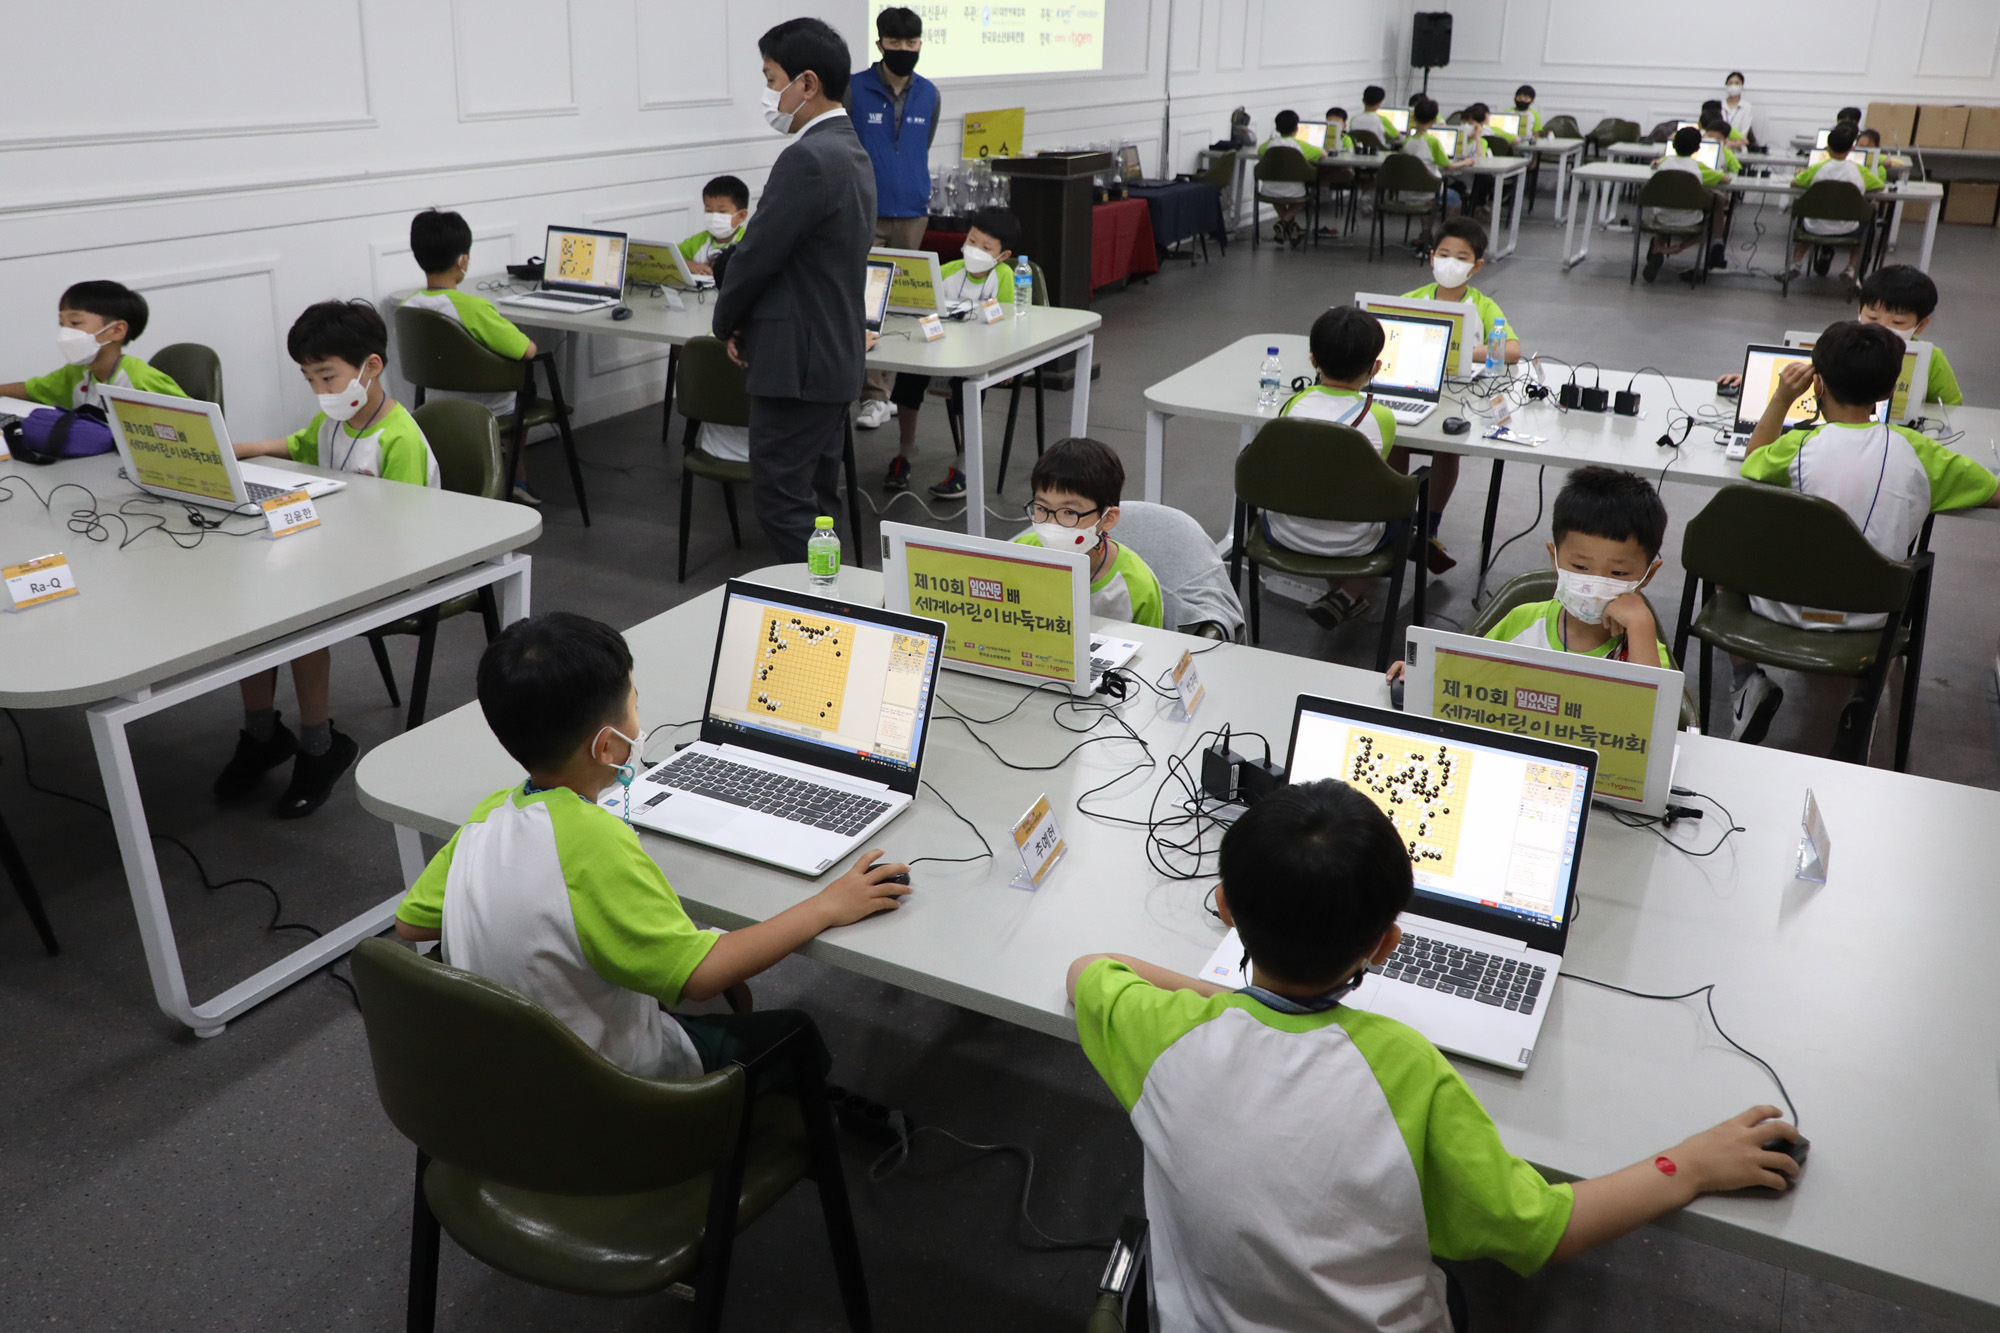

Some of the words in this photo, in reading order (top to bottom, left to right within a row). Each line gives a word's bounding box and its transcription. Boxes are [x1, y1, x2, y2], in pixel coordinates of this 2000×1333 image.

[29, 577, 63, 594] Ra-Q
[914, 572, 964, 596] 제10회
[969, 579, 1003, 601] 일요신문
[1006, 588, 1021, 604] 배
[1442, 678, 1509, 707] 제10회
[1516, 690, 1558, 713] 일요신문
[1564, 702, 1582, 719] 배
[1610, 782, 1637, 792] tygem
